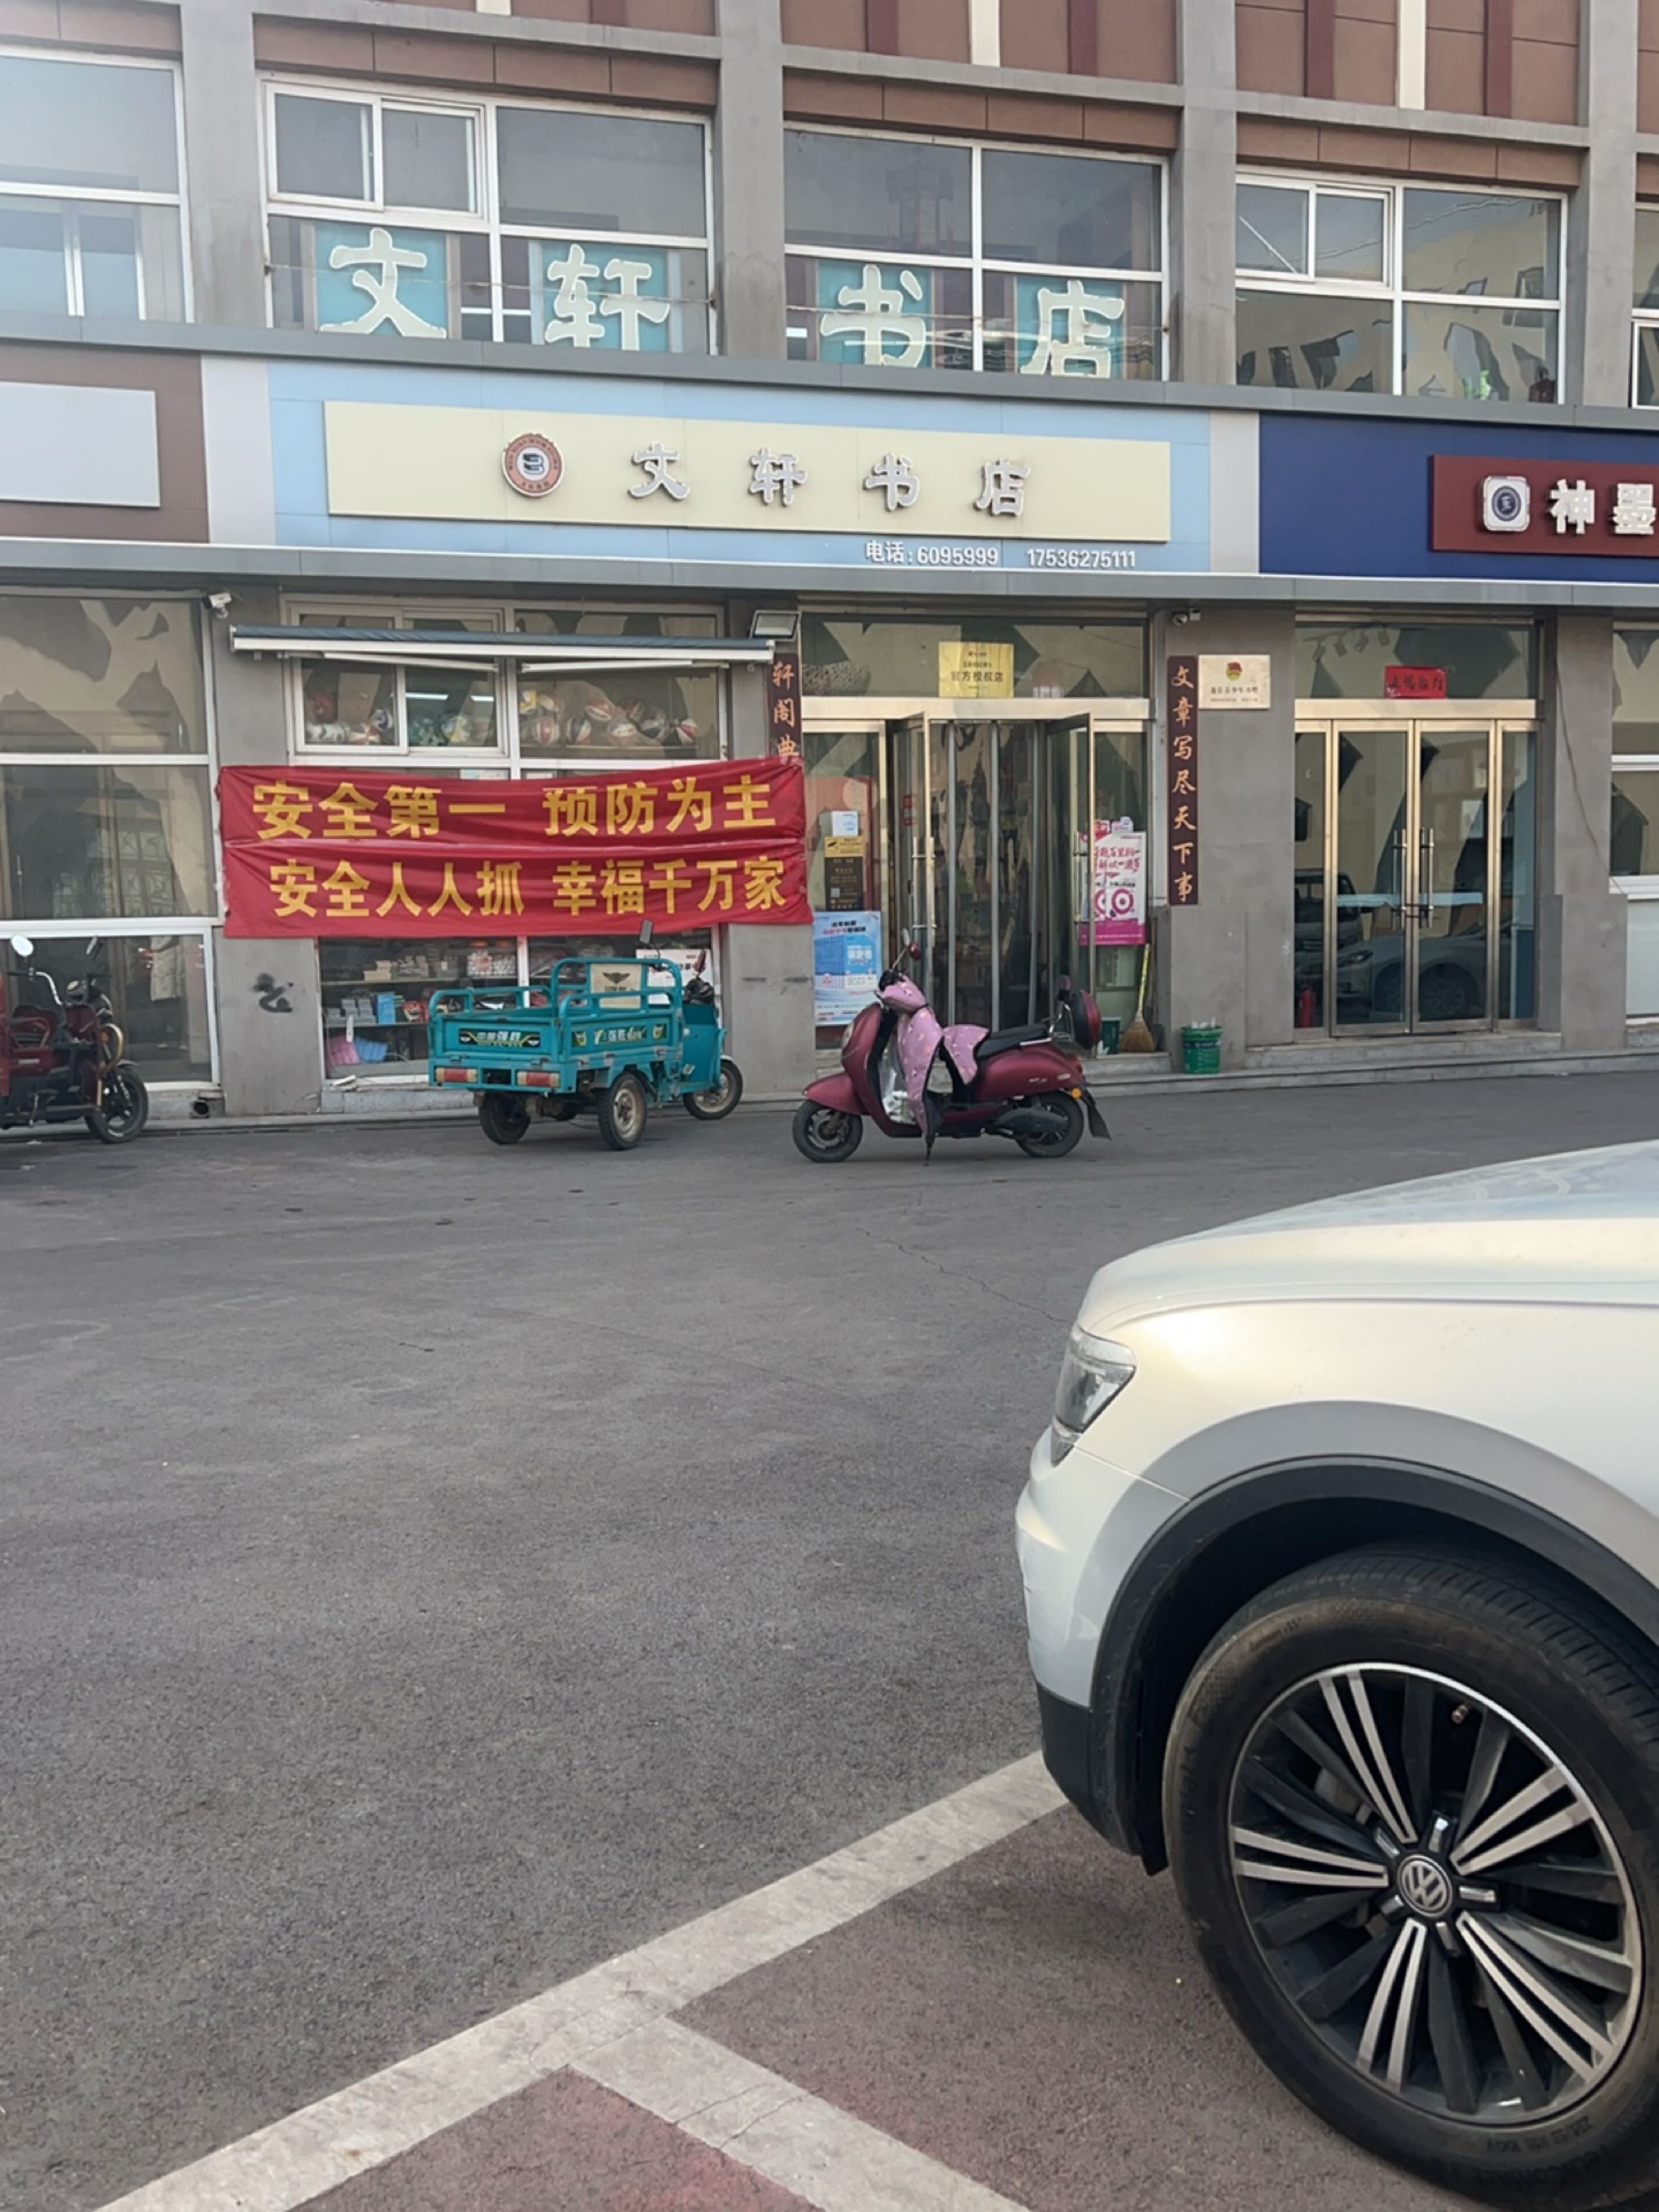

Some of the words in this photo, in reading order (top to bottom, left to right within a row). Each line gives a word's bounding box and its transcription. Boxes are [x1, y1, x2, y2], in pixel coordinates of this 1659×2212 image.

[320, 227, 1125, 379] 文轩书店
[628, 442, 1032, 517] 文轩书店
[1550, 478, 1657, 535] 神墨
[1027, 549, 1136, 568] 17536275111
[252, 782, 507, 840] 安全第一
[543, 774, 777, 837] 预防为主
[1171, 664, 1197, 903] 文章写尽天下事
[269, 858, 525, 918] 安全人人抓
[552, 855, 787, 917] 幸福千万家
